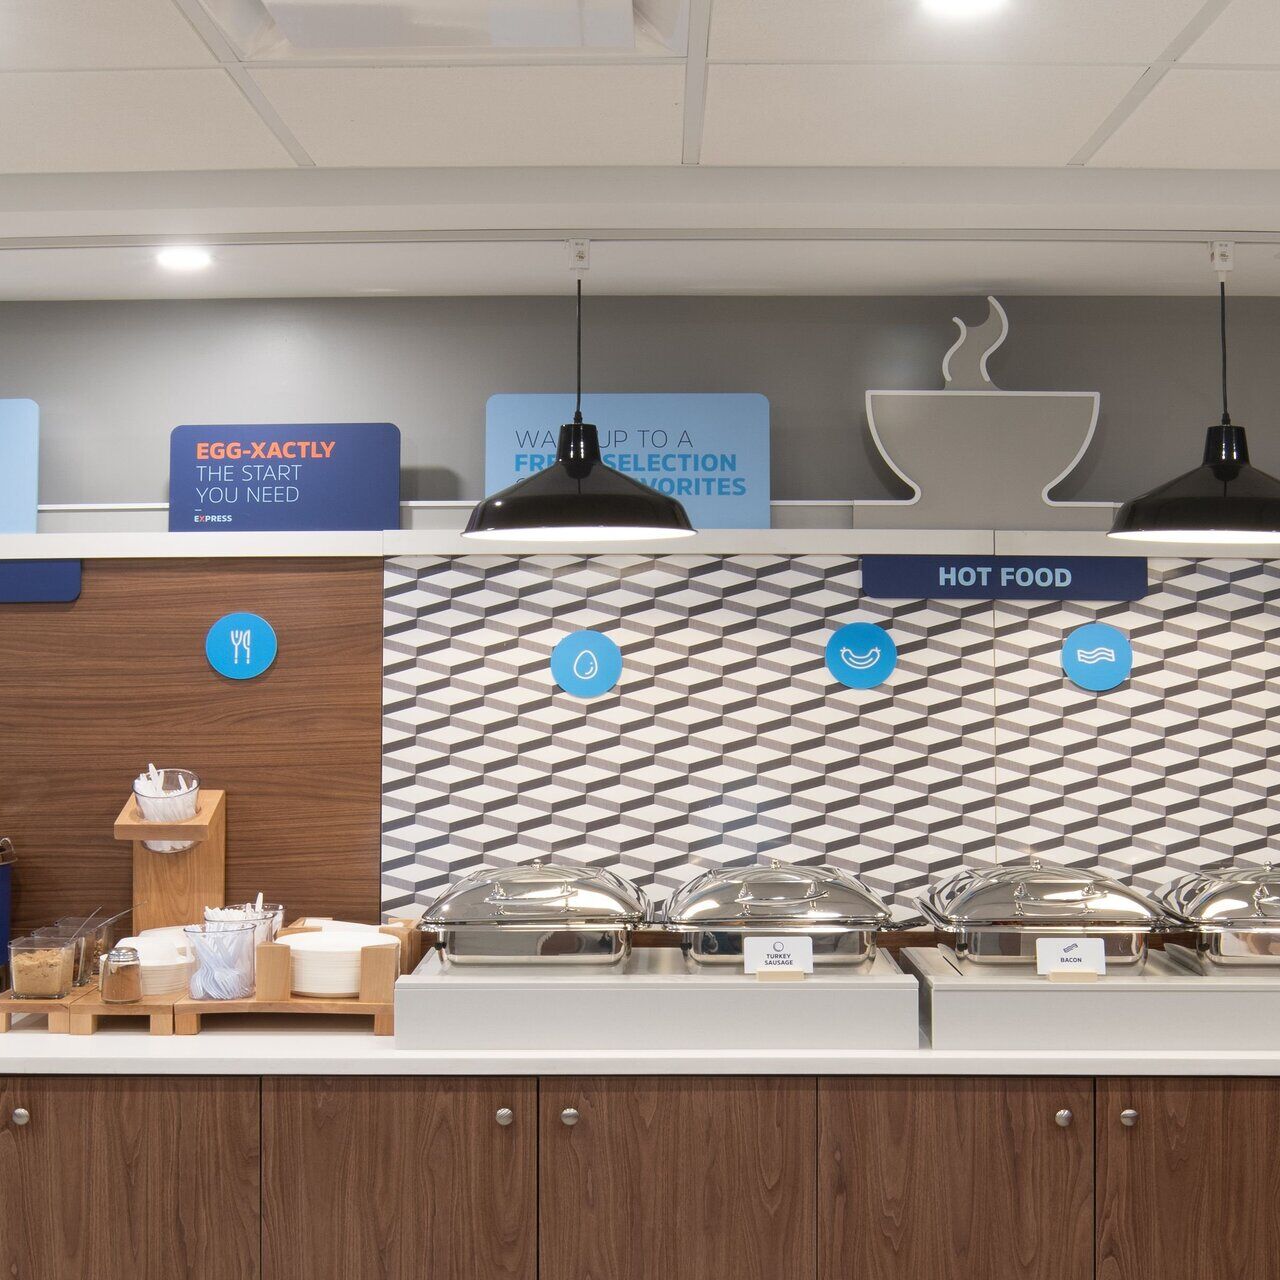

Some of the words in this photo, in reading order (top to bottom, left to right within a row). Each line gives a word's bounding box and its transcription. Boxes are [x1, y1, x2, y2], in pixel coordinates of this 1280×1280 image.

[515, 429, 557, 448] WA
[637, 429, 668, 449] TO
[677, 429, 694, 448] A
[196, 441, 336, 460] EGG-XACTLY
[602, 453, 737, 472] SELECTION
[196, 465, 235, 482] THE
[241, 464, 302, 482] START
[195, 486, 239, 503] YOU
[246, 486, 300, 503] NEED
[194, 514, 233, 523] EXPRESS
[939, 566, 993, 587] HOT
[1000, 567, 1072, 588] FOOD
